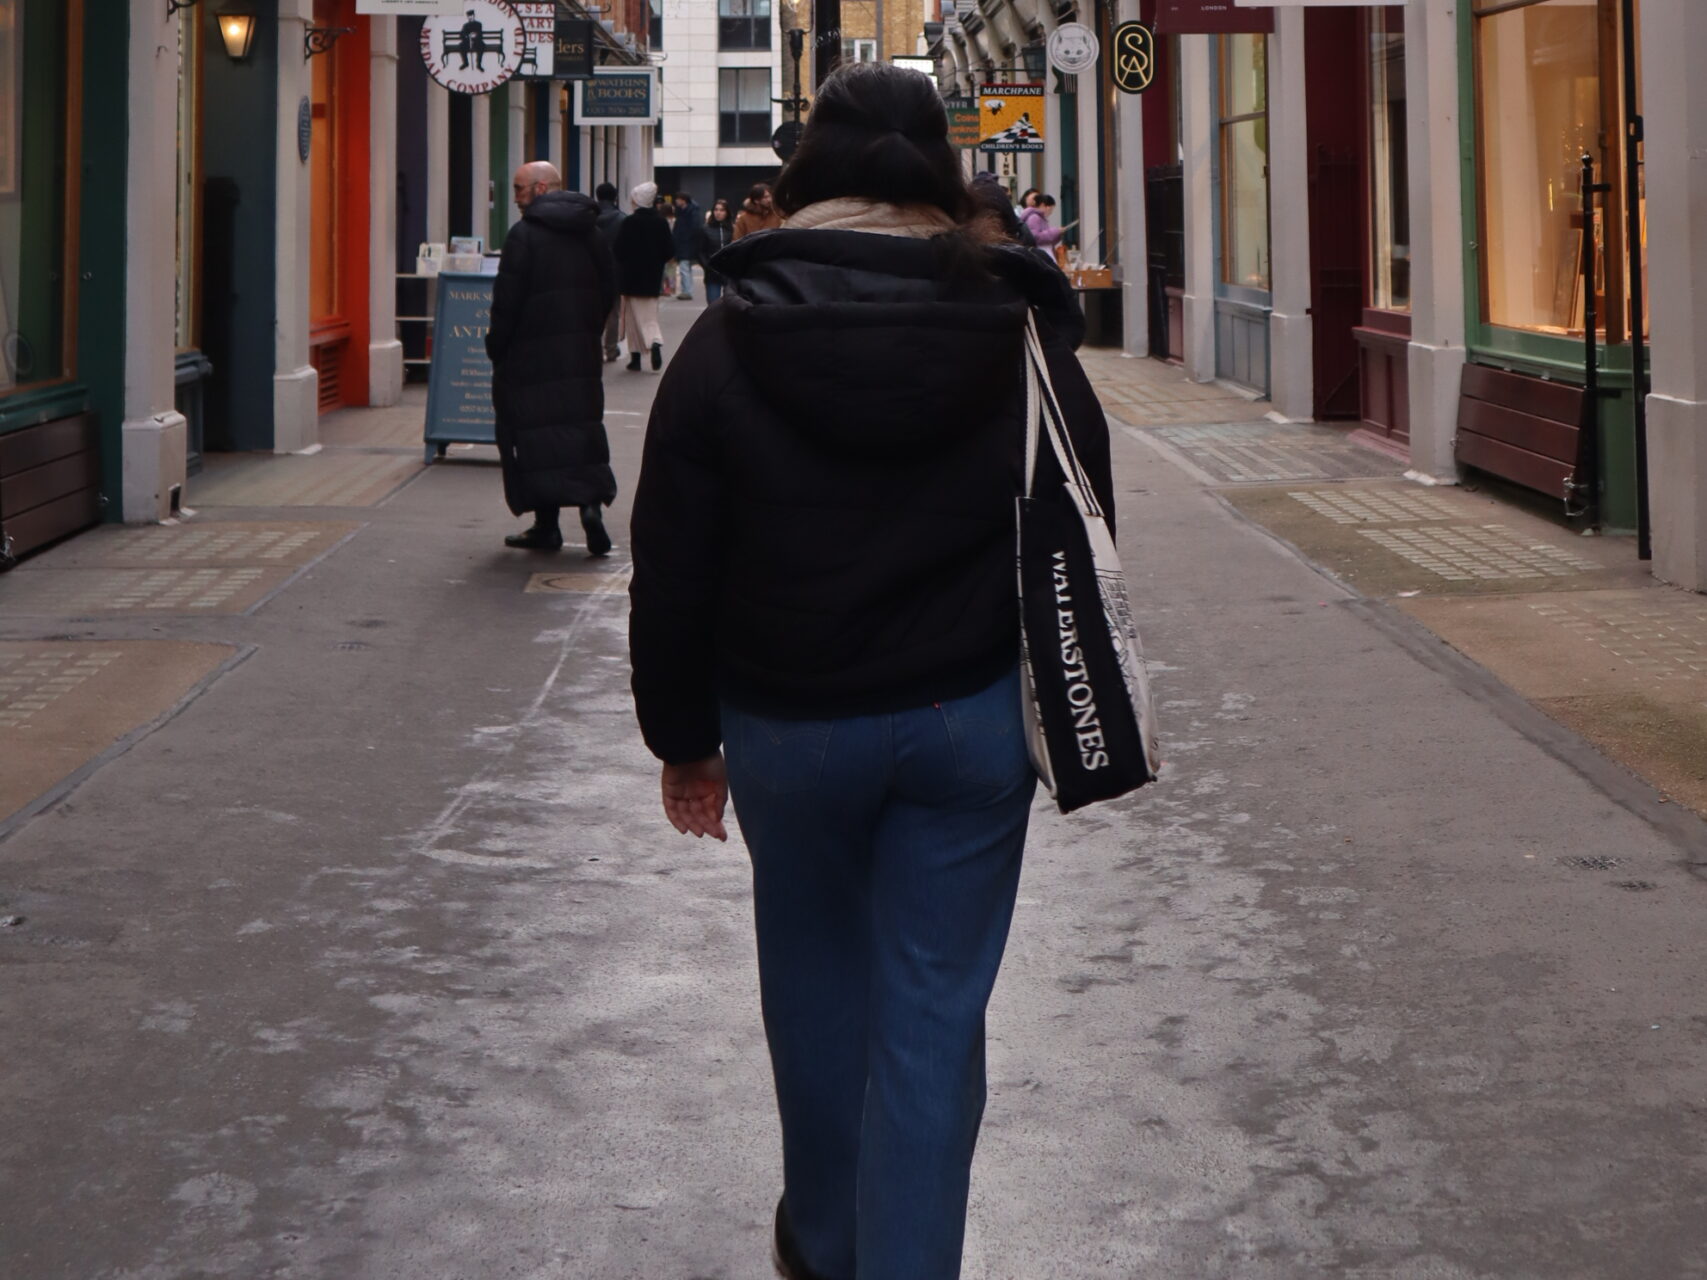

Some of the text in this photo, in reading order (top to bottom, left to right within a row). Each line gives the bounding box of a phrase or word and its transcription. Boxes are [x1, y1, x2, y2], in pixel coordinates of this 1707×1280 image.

[554, 37, 584, 54] ders
[420, 26, 524, 94] MEDAL COMPANY LTD
[598, 88, 648, 99] BOOKS
[982, 87, 1042, 96] MARCHPANE
